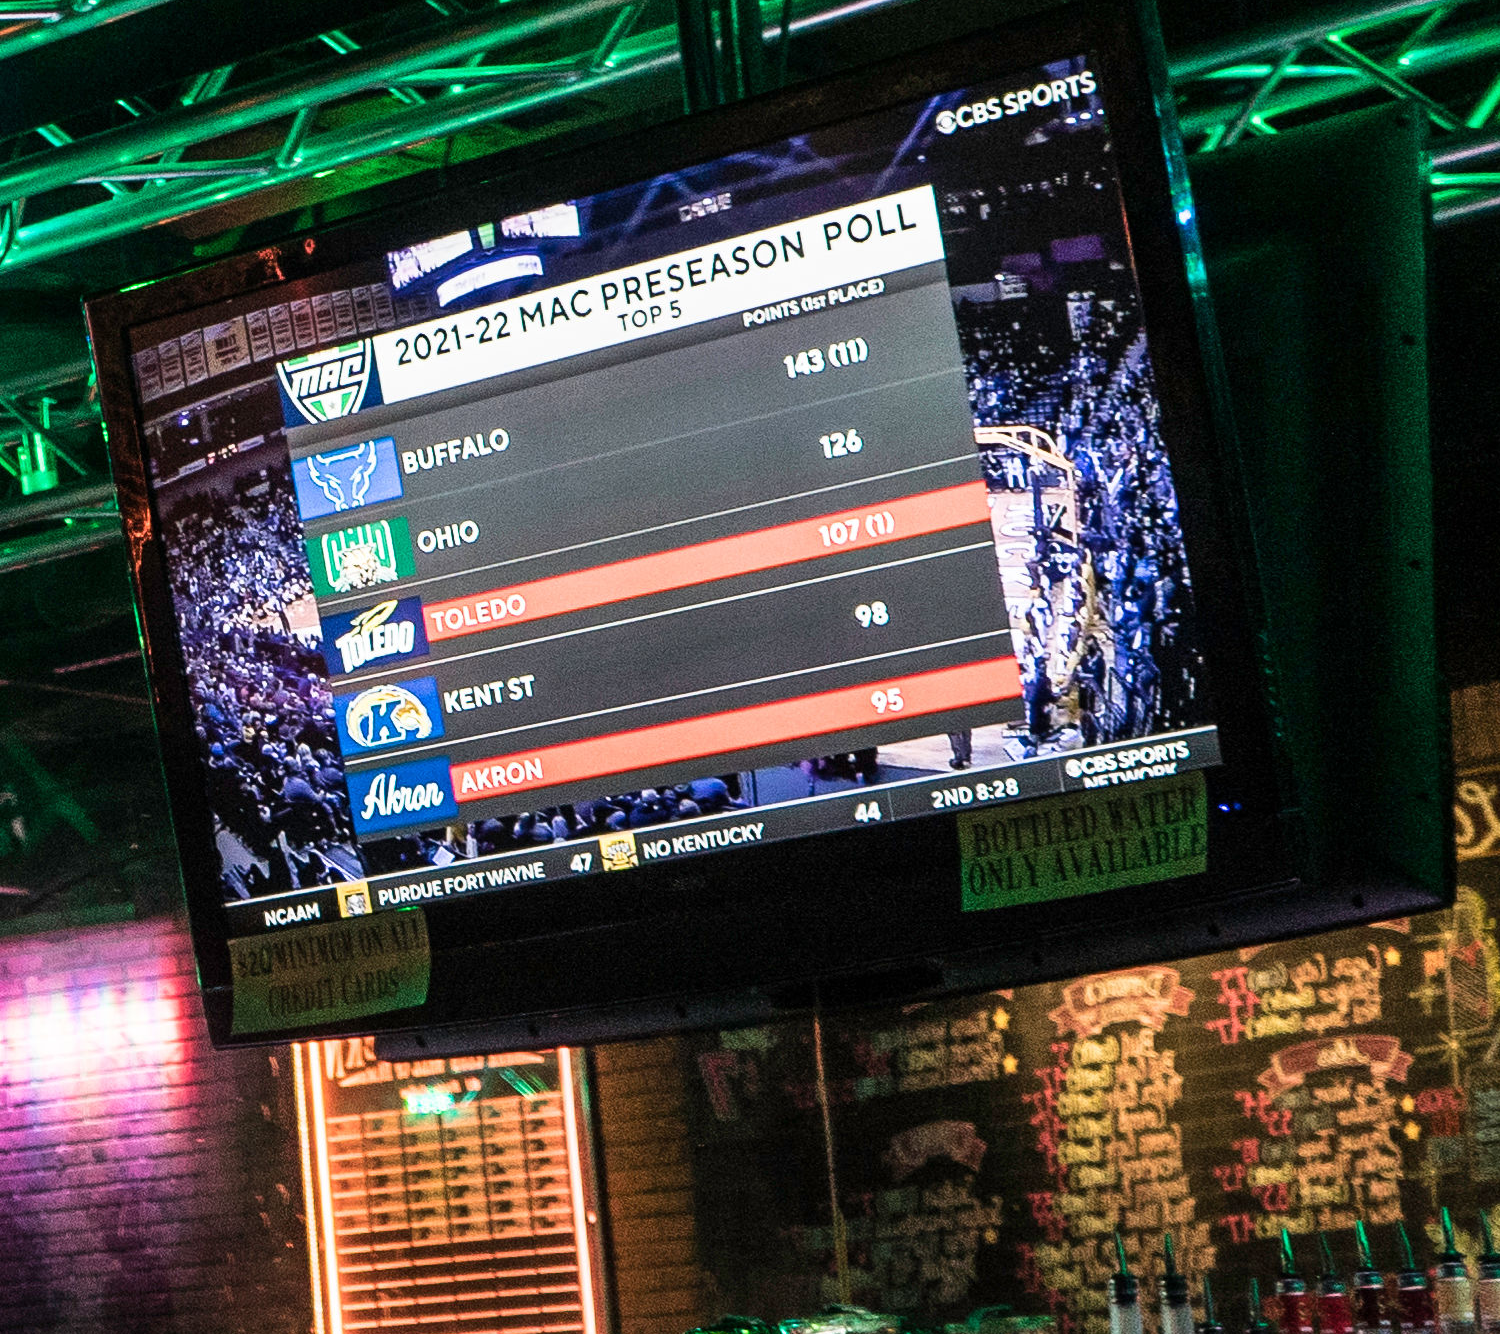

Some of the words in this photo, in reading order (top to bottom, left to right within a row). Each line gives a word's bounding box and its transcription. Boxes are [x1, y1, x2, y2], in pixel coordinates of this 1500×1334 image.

[956, 97, 1002, 129] CBS
[1003, 71, 1097, 114] SPORTS
[395, 312, 511, 366] 2021-22
[518, 289, 593, 333] MAC
[600, 229, 805, 311] PRESEASON
[823, 203, 917, 252] POLL
[742, 299, 800, 327] POINTS
[828, 278, 886, 306] PLACE)
[617, 305, 663, 332] TOP
[670, 302, 683, 320] 5
[783, 348, 826, 379] 143
[828, 337, 869, 367] (11)
[288, 359, 366, 398] MAC
[401, 428, 511, 475] BUFFALO
[819, 429, 863, 459] 126
[416, 520, 481, 554] OHIO
[818, 518, 861, 548] 107
[865, 511, 896, 538] (1)
[430, 594, 527, 633] TOLEDO
[854, 600, 890, 628] 98
[335, 621, 416, 673] TOLEDO
[443, 681, 504, 714] KENT
[508, 675, 536, 700] ST
[871, 687, 905, 714] 95
[460, 758, 543, 794] AKRON
[1080, 753, 1117, 774] CBS
[1117, 740, 1190, 767] SPORTS
[361, 773, 444, 820] Akron
[642, 838, 671, 860] NO
[672, 823, 765, 855] KENTUCKY
[854, 801, 882, 823] 44
[931, 786, 974, 809] 2ND
[976, 778, 1020, 801] 8:28
[973, 804, 1097, 857] BOTTLED
[1107, 784, 1199, 832] WATER
[377, 879, 443, 907] PURDUE
[444, 873, 485, 895] FORT
[486, 861, 547, 886] WAYNE
[570, 852, 592, 873] 47
[970, 851, 1040, 896] ONLY
[1053, 824, 1203, 882] AVAILABLE
[264, 902, 320, 927] NCAAM
